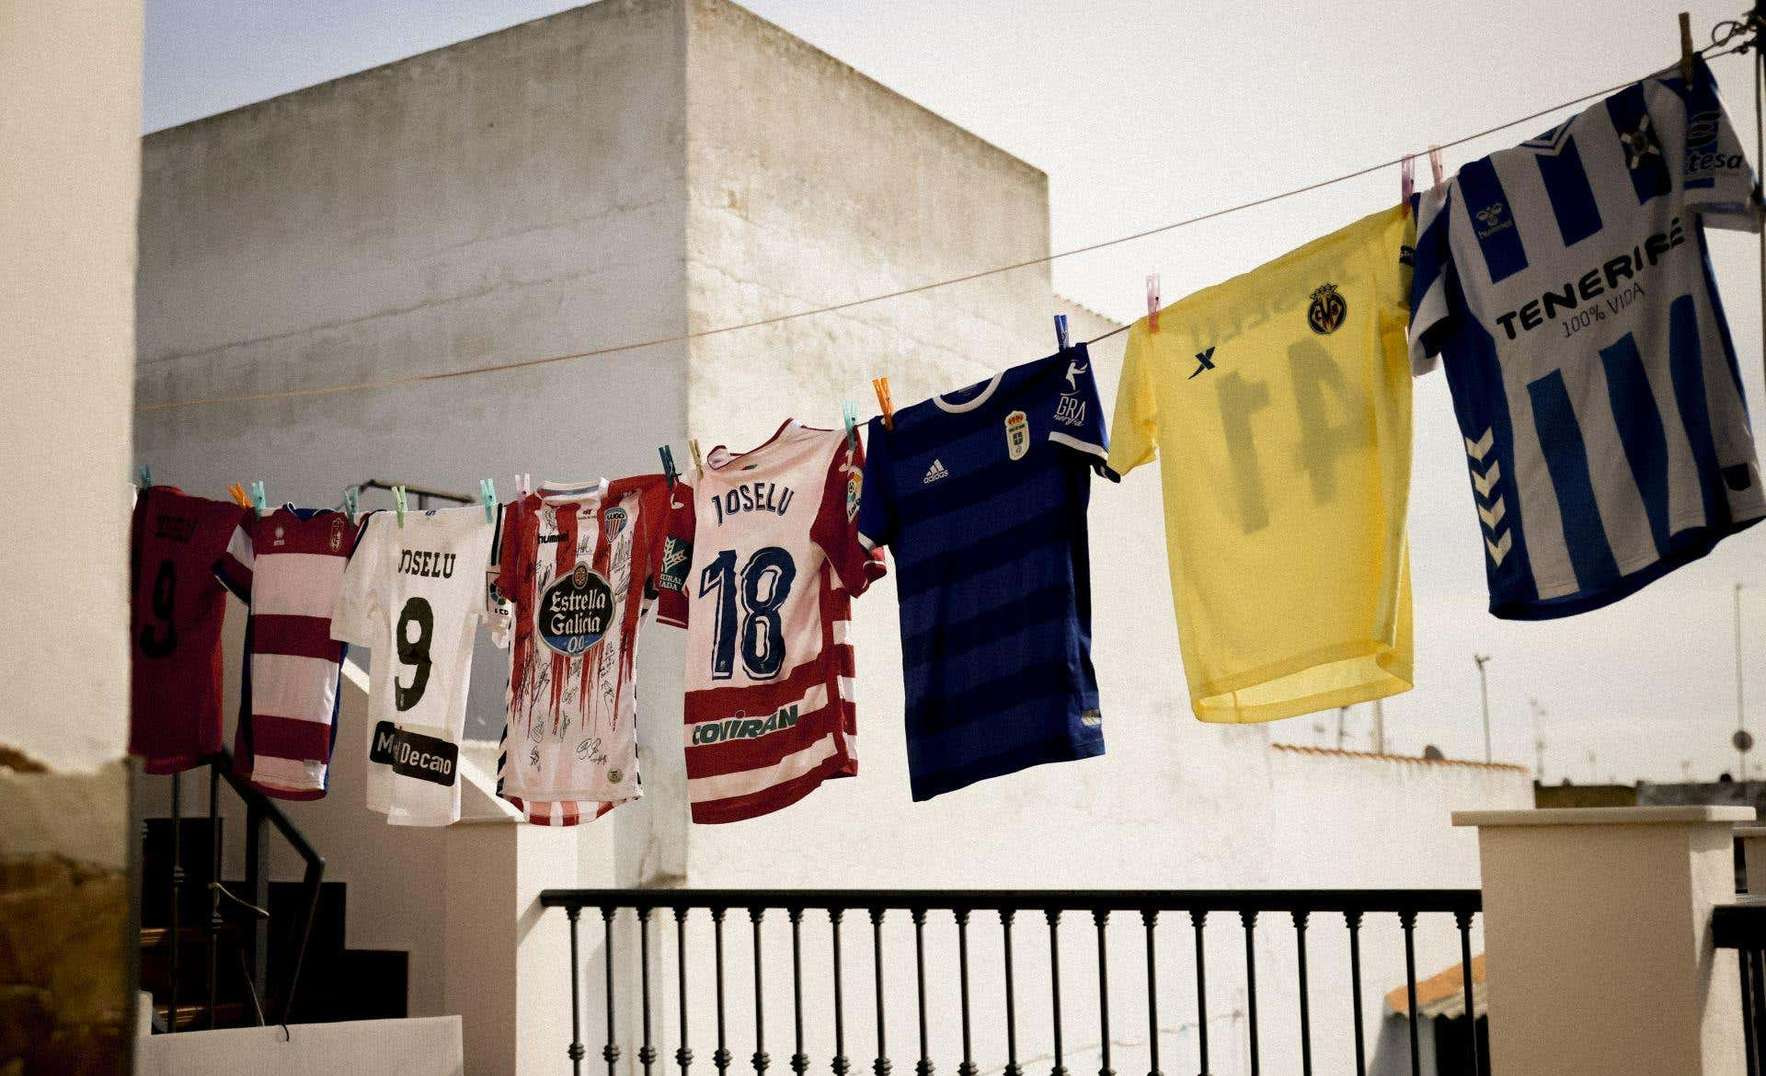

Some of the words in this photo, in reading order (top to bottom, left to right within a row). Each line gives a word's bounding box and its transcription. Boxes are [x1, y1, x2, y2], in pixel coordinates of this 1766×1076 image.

[1496, 217, 1685, 340] TENERIFE
[1562, 303, 1606, 338] 100%
[1607, 282, 1645, 315] VIDA
[923, 469, 949, 484] adidas
[711, 482, 795, 528] JOSELU
[549, 588, 606, 613] Estrella
[550, 611, 601, 636] Galicia
[699, 546, 797, 681] 18
[394, 596, 434, 712] 9
[692, 703, 799, 746] COVIRAN
